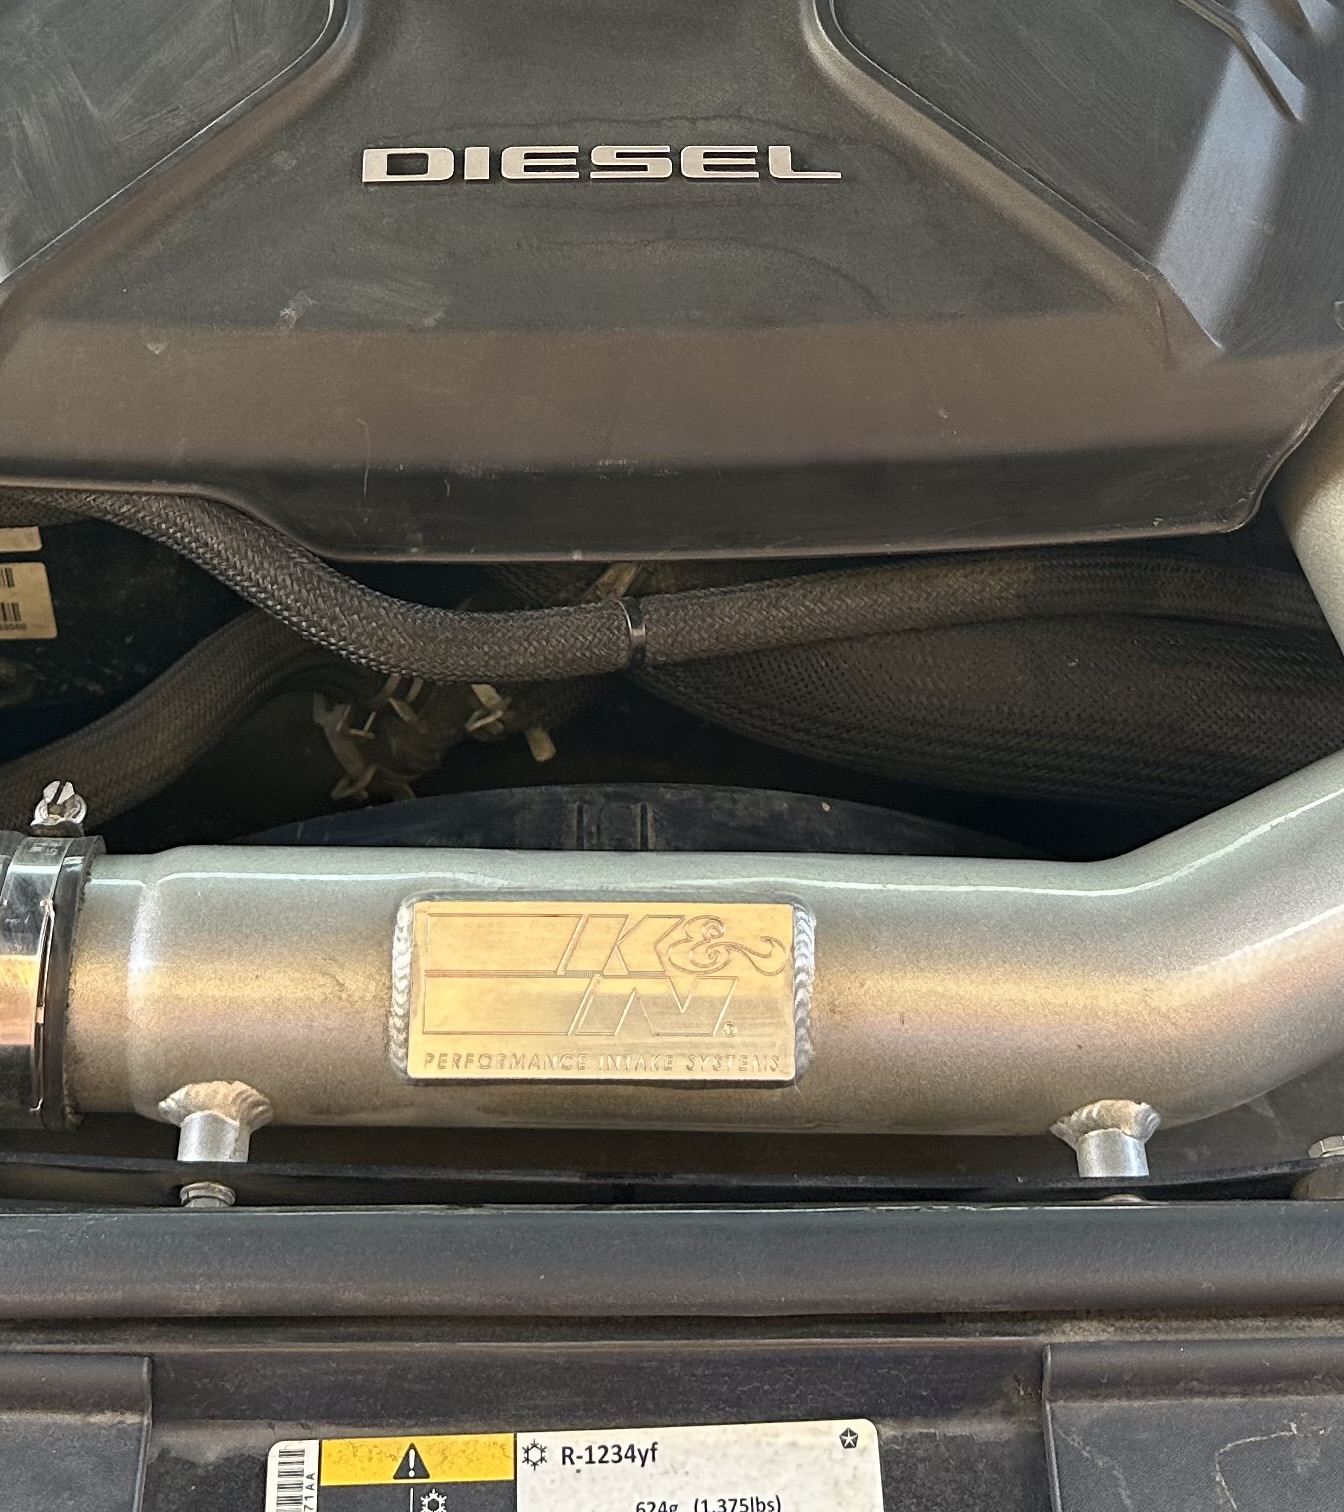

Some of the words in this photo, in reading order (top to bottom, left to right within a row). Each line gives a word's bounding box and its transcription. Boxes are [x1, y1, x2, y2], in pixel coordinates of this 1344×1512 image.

[362, 145, 843, 183] DIESEL
[423, 1052, 587, 1072] PERFORMANCE
[598, 1053, 674, 1072] INTAKE
[685, 1053, 780, 1073] SYSTEMS
[561, 1441, 659, 1467] R-1234yf
